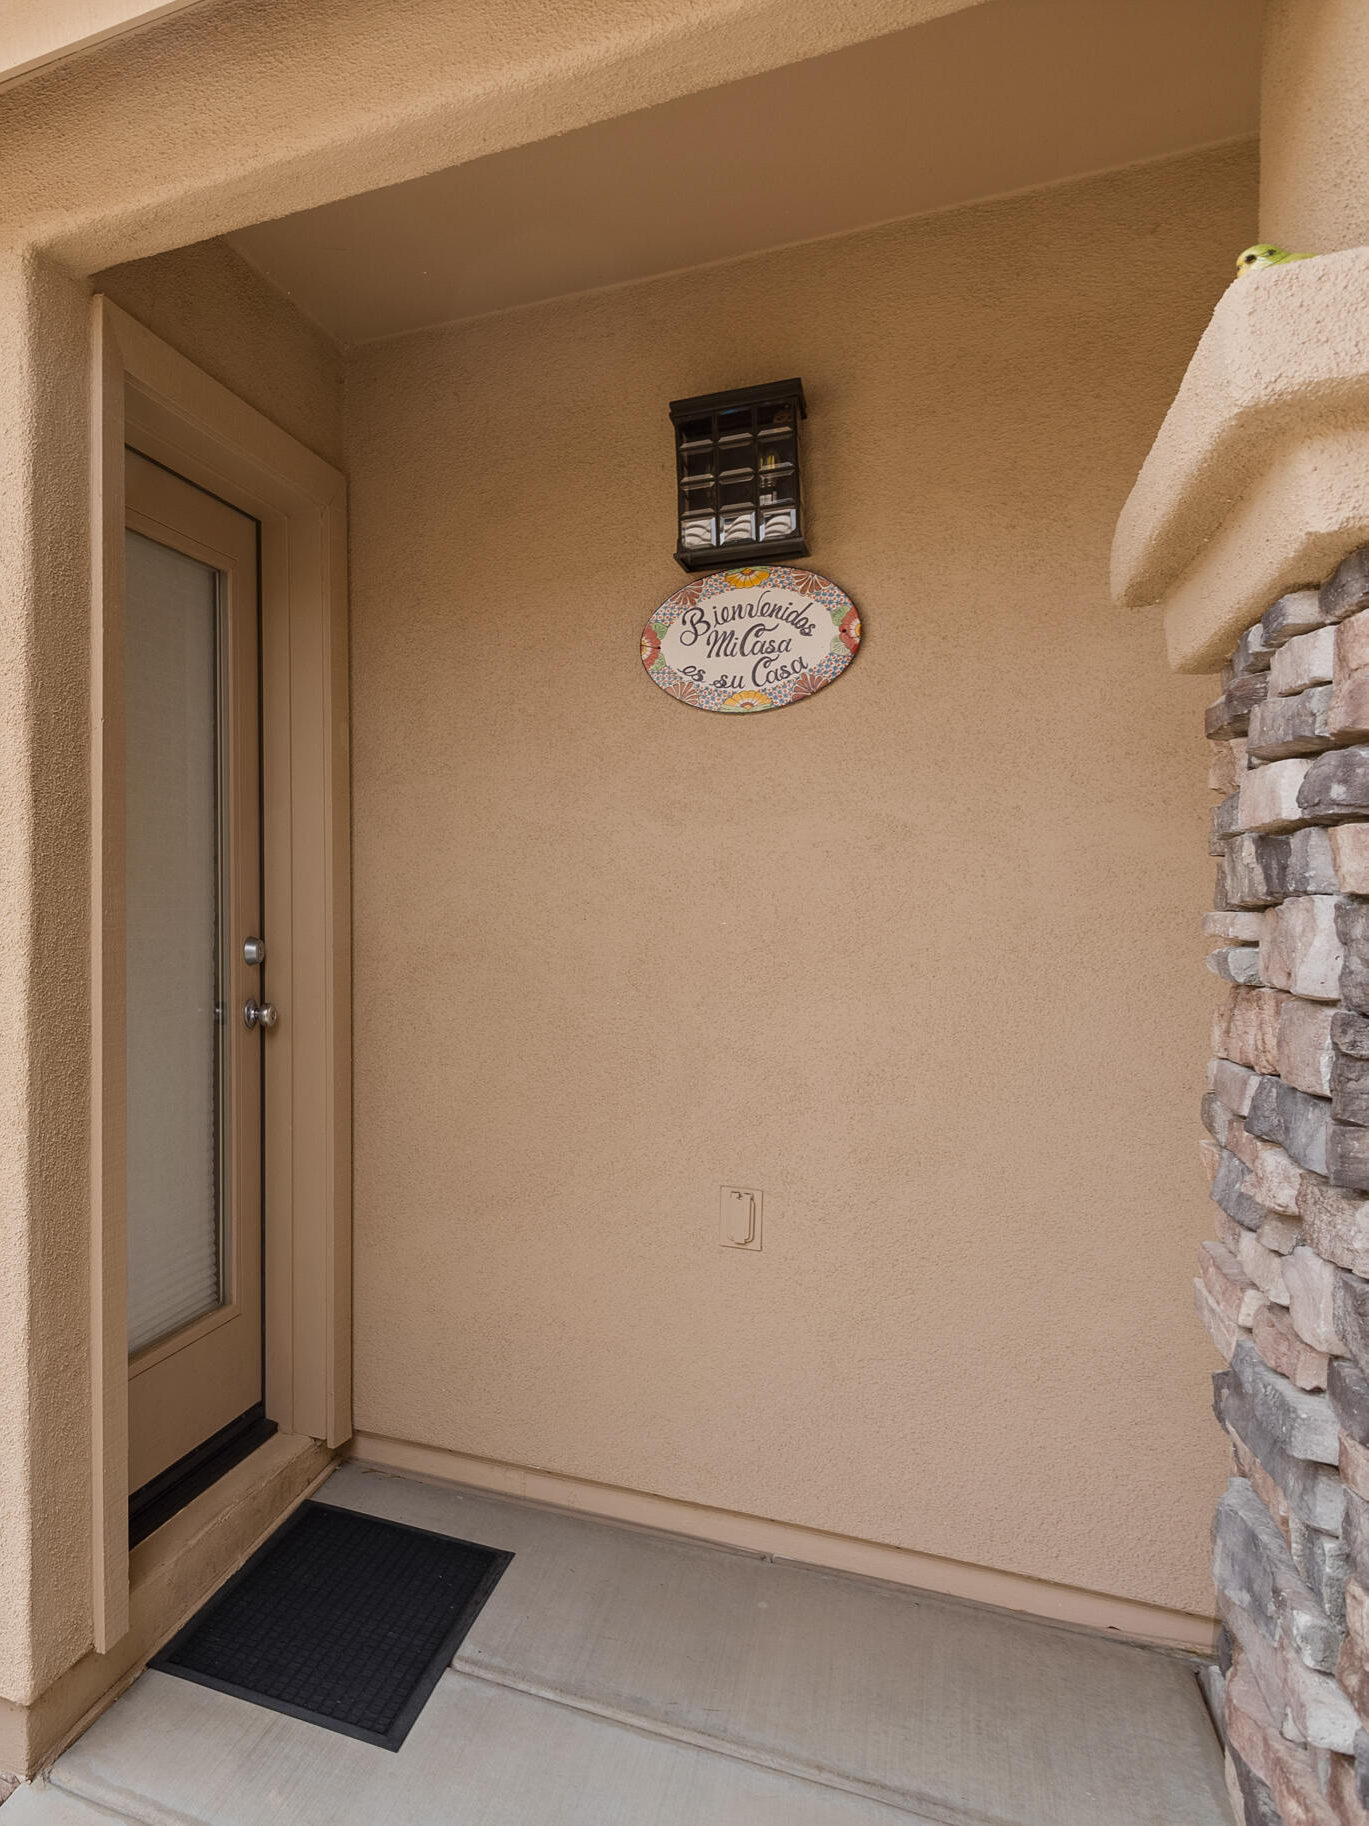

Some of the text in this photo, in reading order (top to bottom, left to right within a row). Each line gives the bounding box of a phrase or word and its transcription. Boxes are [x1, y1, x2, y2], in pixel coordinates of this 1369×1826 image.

[680, 590, 816, 646] Bienvenidos
[706, 623, 792, 658] Mi Casa
[677, 654, 808, 690] es su Casa
